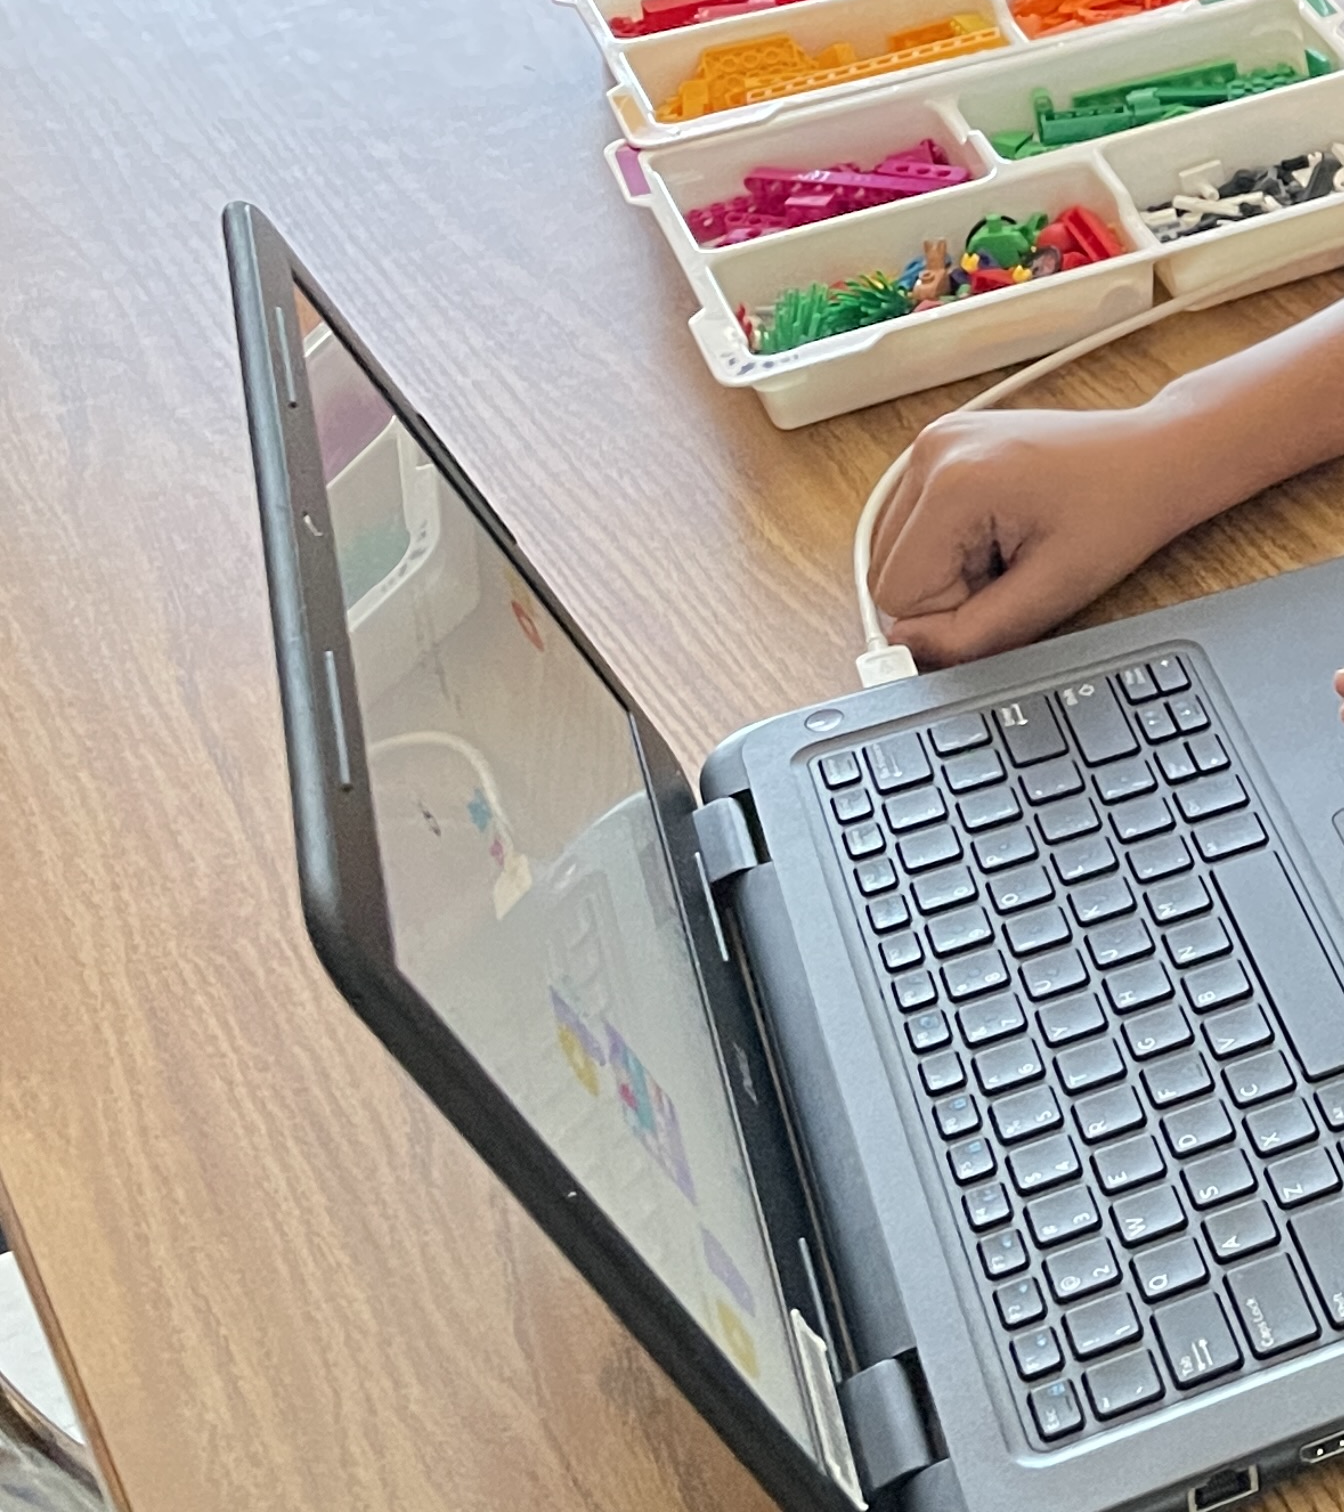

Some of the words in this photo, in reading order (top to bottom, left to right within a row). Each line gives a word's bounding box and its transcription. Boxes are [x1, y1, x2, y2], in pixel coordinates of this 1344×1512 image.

[1066, 864, 1083, 878] L
[1003, 892, 1019, 908] O
[1083, 903, 1100, 919] K
[1159, 900, 1176, 918] M
[1102, 949, 1119, 959] J
[1178, 945, 1197, 962] N
[985, 970, 1002, 982] 8
[1034, 980, 1051, 992] U
[1118, 989, 1135, 1005] H
[1197, 990, 1217, 1004] B
[1000, 1016, 1017, 1028] 7
[1052, 1025, 1069, 1039] Y
[1137, 1037, 1155, 1050] G
[1217, 1035, 1235, 1052] V
[1017, 1063, 1034, 1075] 6
[1069, 1071, 1087, 1086] T
[1159, 1087, 1177, 1101] F
[1240, 1081, 1260, 1098] C
[1035, 1110, 1053, 1122] 5
[1088, 1120, 1106, 1136] R
[1178, 1133, 1199, 1150] D
[1262, 1130, 1282, 1146] X
[1107, 1170, 1127, 1183] E
[1201, 1184, 1220, 1201] S
[1283, 1183, 1304, 1200] Z
[1074, 1211, 1091, 1224] 3
[1126, 1218, 1146, 1236] W
[1223, 1234, 1241, 1251] A
[1092, 1264, 1111, 1276] 2
[1148, 1273, 1169, 1291] Q
[1246, 1298, 1264, 1324] Lock
[1179, 1355, 1193, 1377] Tab
